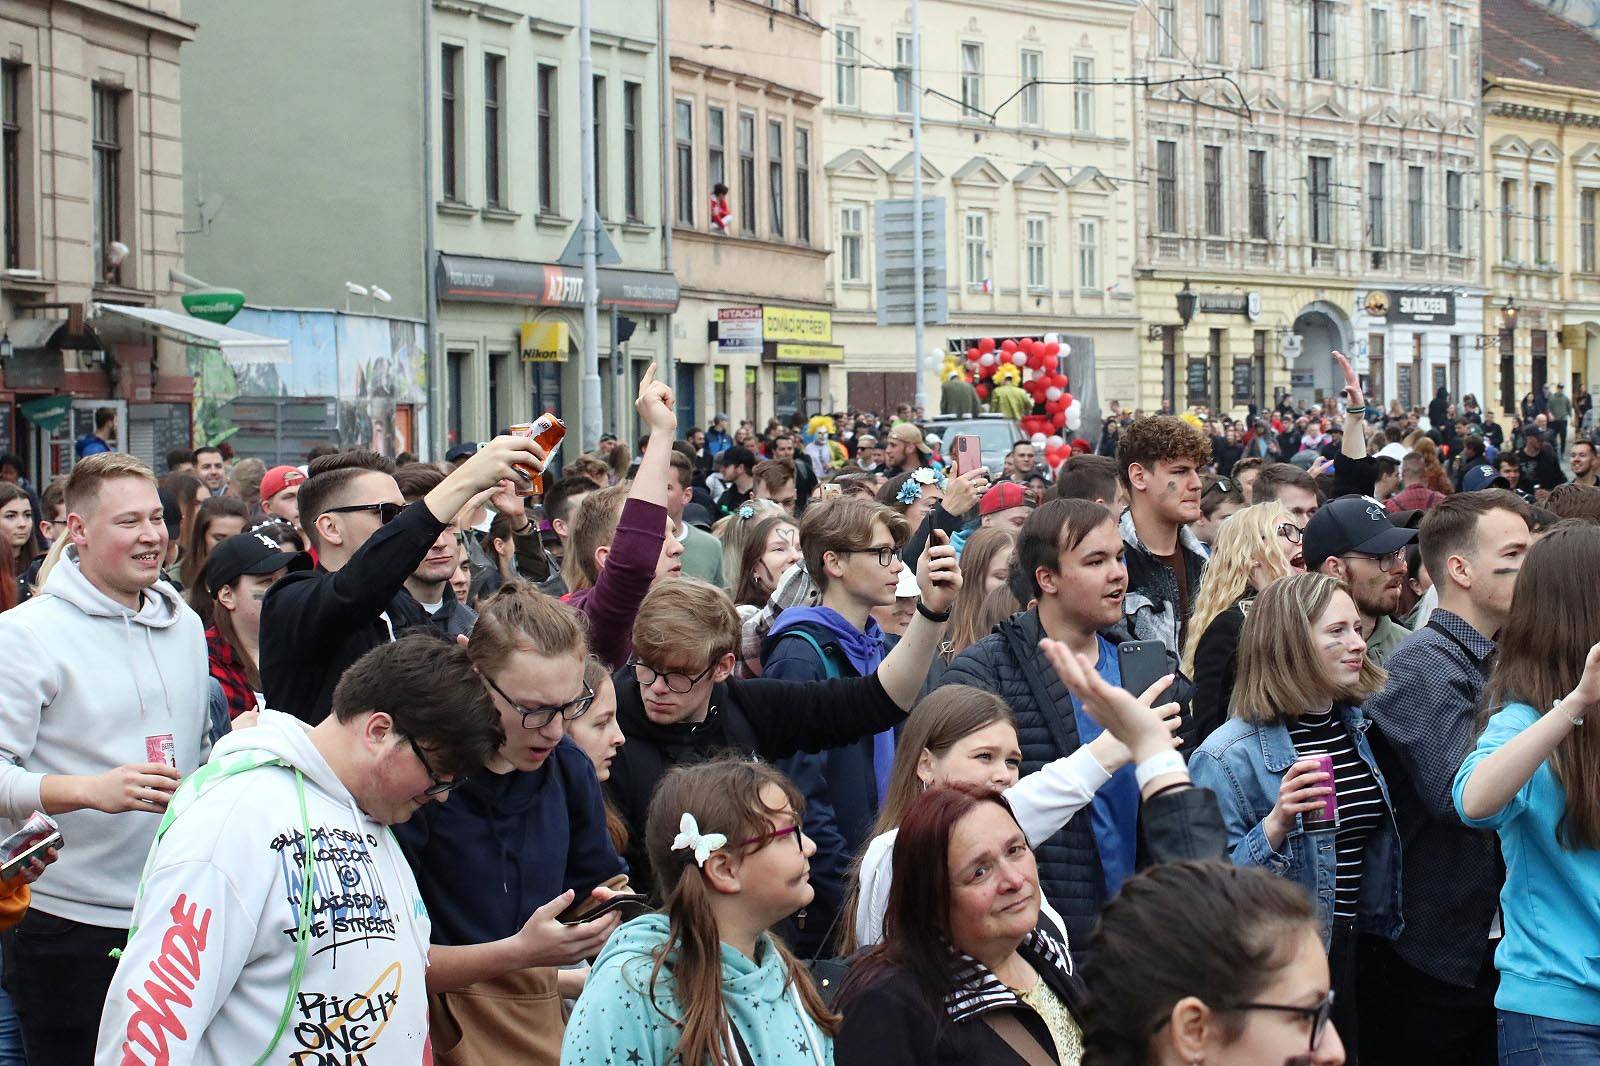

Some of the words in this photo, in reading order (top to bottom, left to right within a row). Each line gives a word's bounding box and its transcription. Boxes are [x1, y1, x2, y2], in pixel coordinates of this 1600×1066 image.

[547, 275, 599, 303] AZFOT
[719, 309, 762, 319] HITACHI
[522, 349, 557, 359] Nikon
[293, 1021, 377, 1053] ONE
